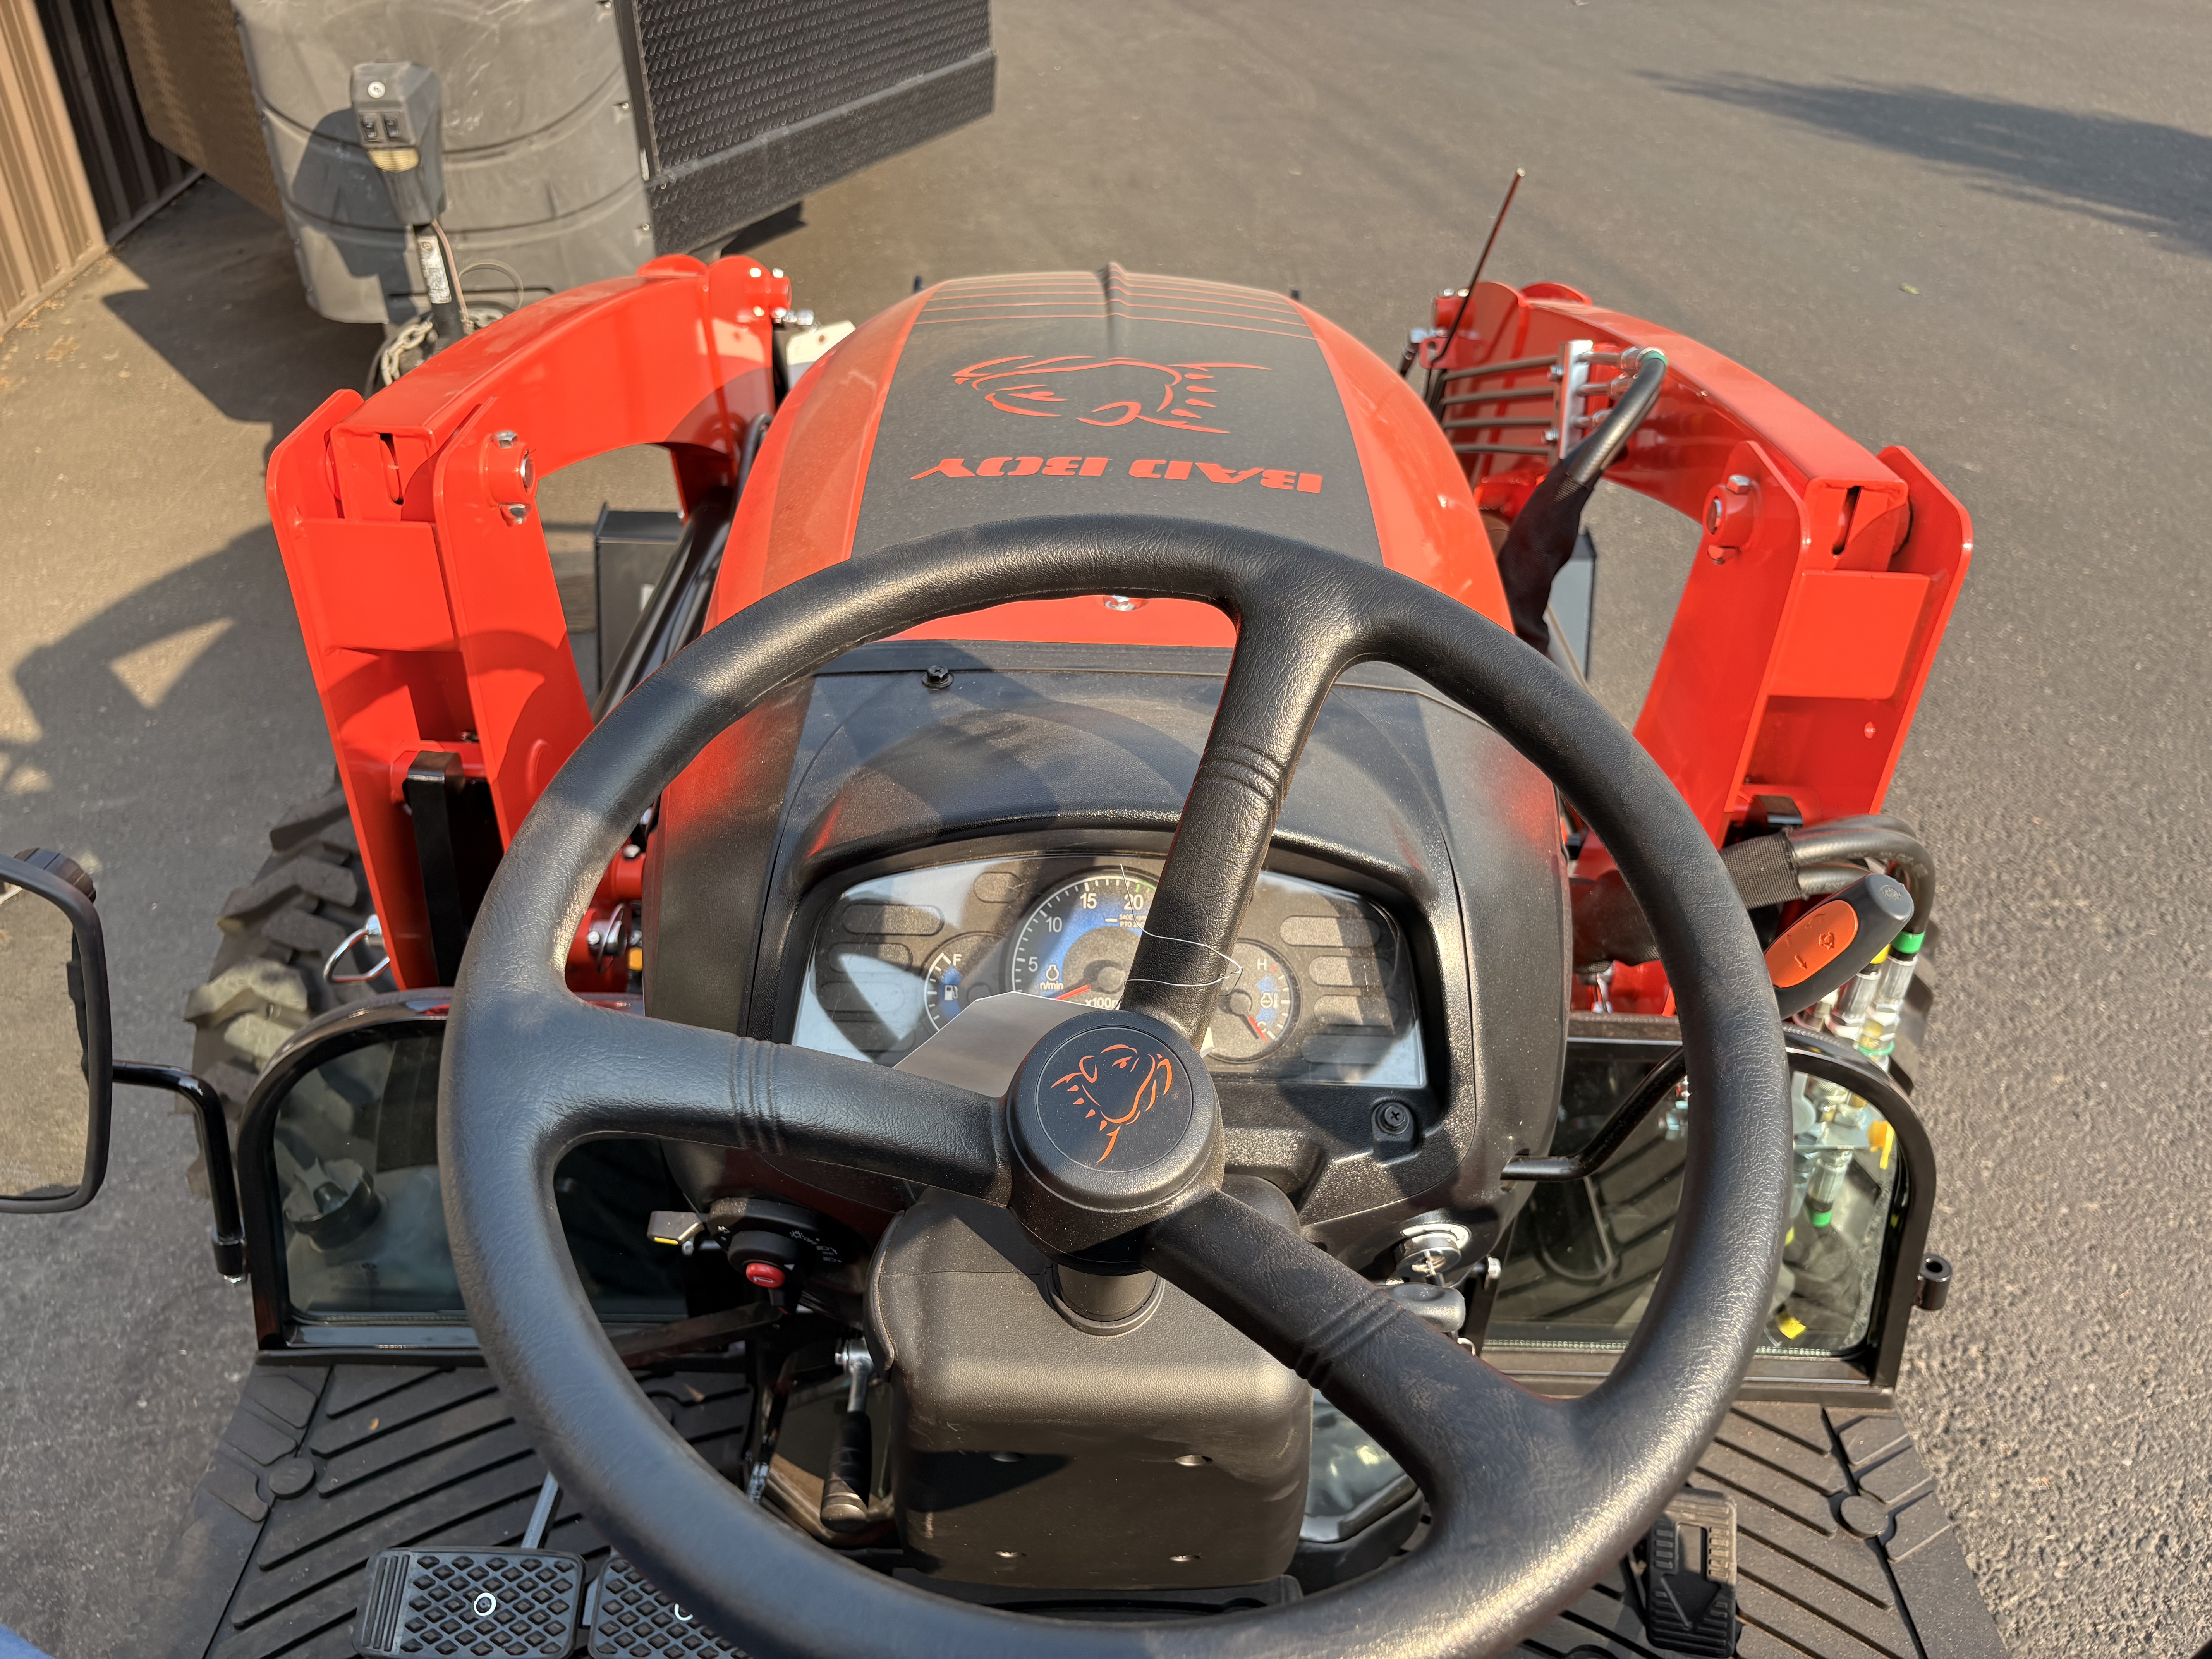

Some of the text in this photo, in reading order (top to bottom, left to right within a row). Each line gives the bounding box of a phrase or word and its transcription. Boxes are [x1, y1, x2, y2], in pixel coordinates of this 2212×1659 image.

[910, 456, 1323, 493] BAD BOY
[1080, 893, 1097, 909] 15
[1124, 894, 1143, 910] 20
[1046, 917, 1062, 932] 10
[953, 954, 962, 966] F
[1029, 957, 1038, 972] 5
[1257, 958, 1267, 970] H
